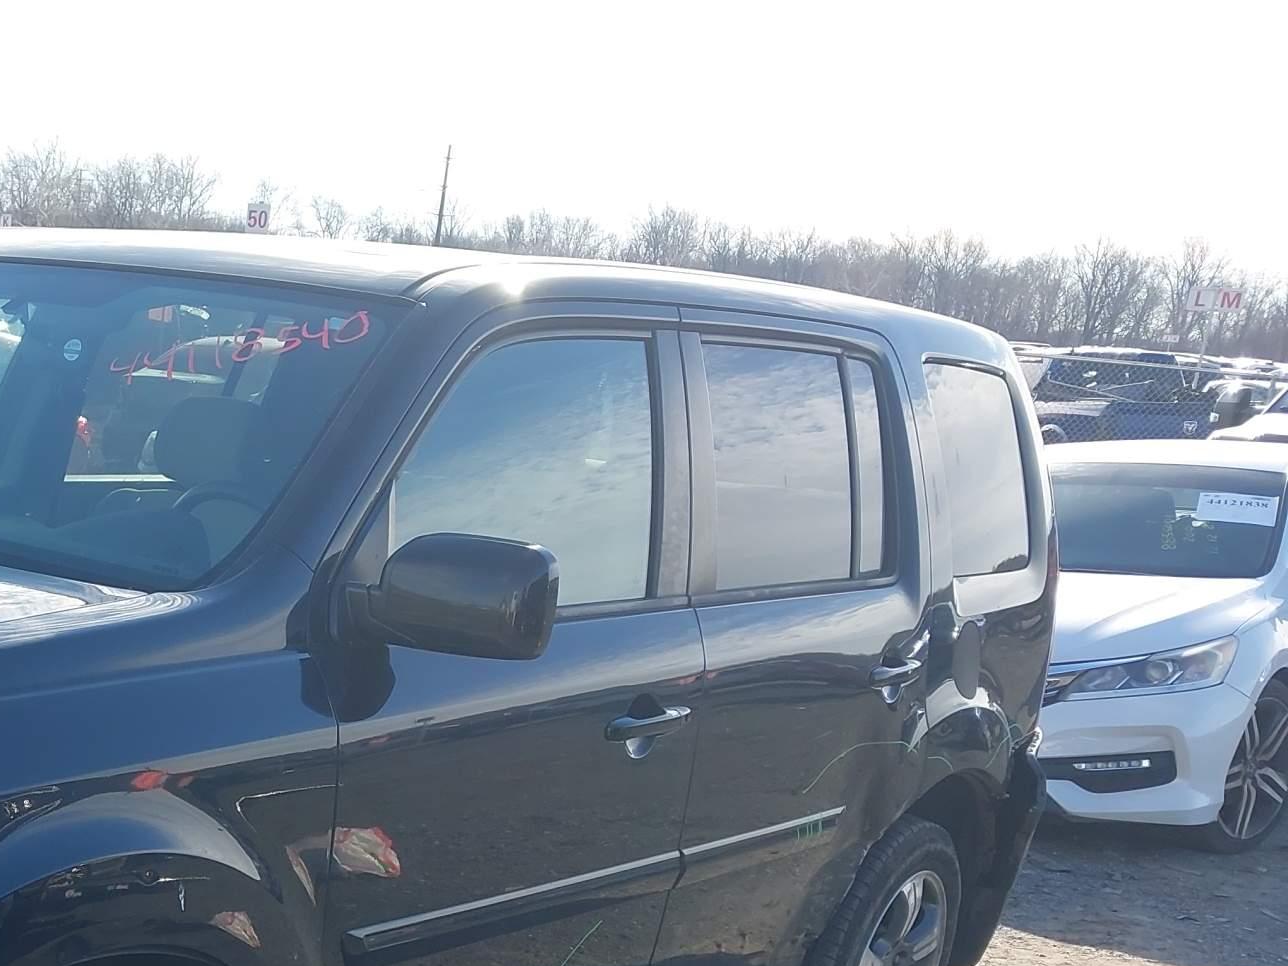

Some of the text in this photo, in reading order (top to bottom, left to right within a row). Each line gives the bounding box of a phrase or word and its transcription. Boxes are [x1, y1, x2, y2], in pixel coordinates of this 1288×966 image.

[247, 210, 268, 229] 50
[1194, 290, 1242, 309] L M
[109, 310, 370, 385] 44118540
